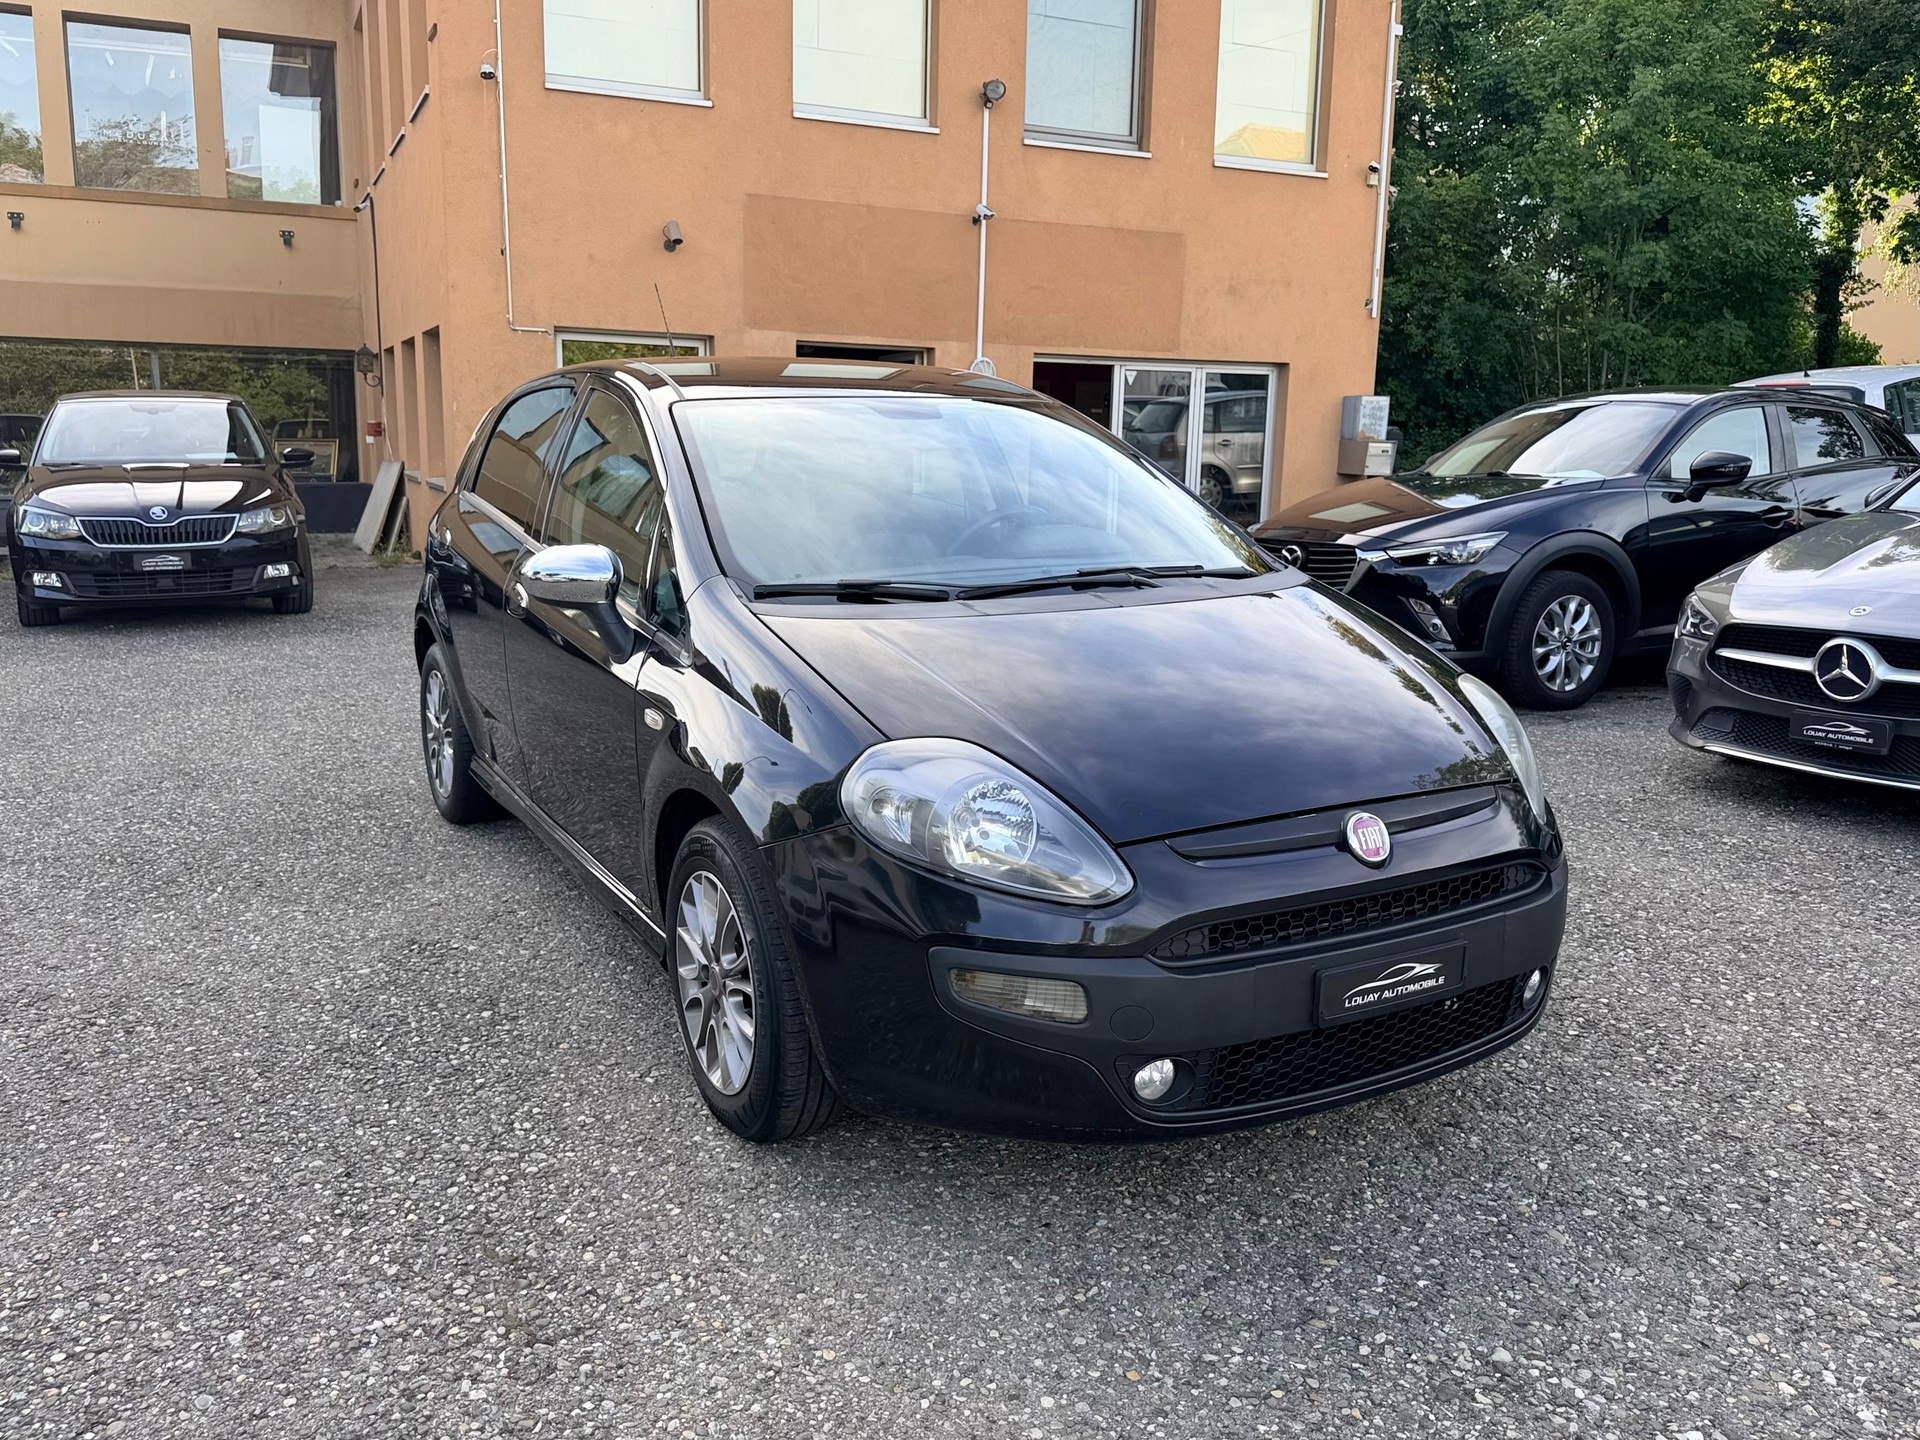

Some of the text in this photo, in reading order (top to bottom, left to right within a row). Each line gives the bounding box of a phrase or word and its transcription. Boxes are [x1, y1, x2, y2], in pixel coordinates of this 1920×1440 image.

[103, 129, 168, 142] MEDUSA
[1803, 729, 1874, 744] LOUAY AUTOMOBILE
[1357, 826, 1383, 851] FIAT
[1344, 975, 1446, 1008] LOUAY AUTOMOBILE
